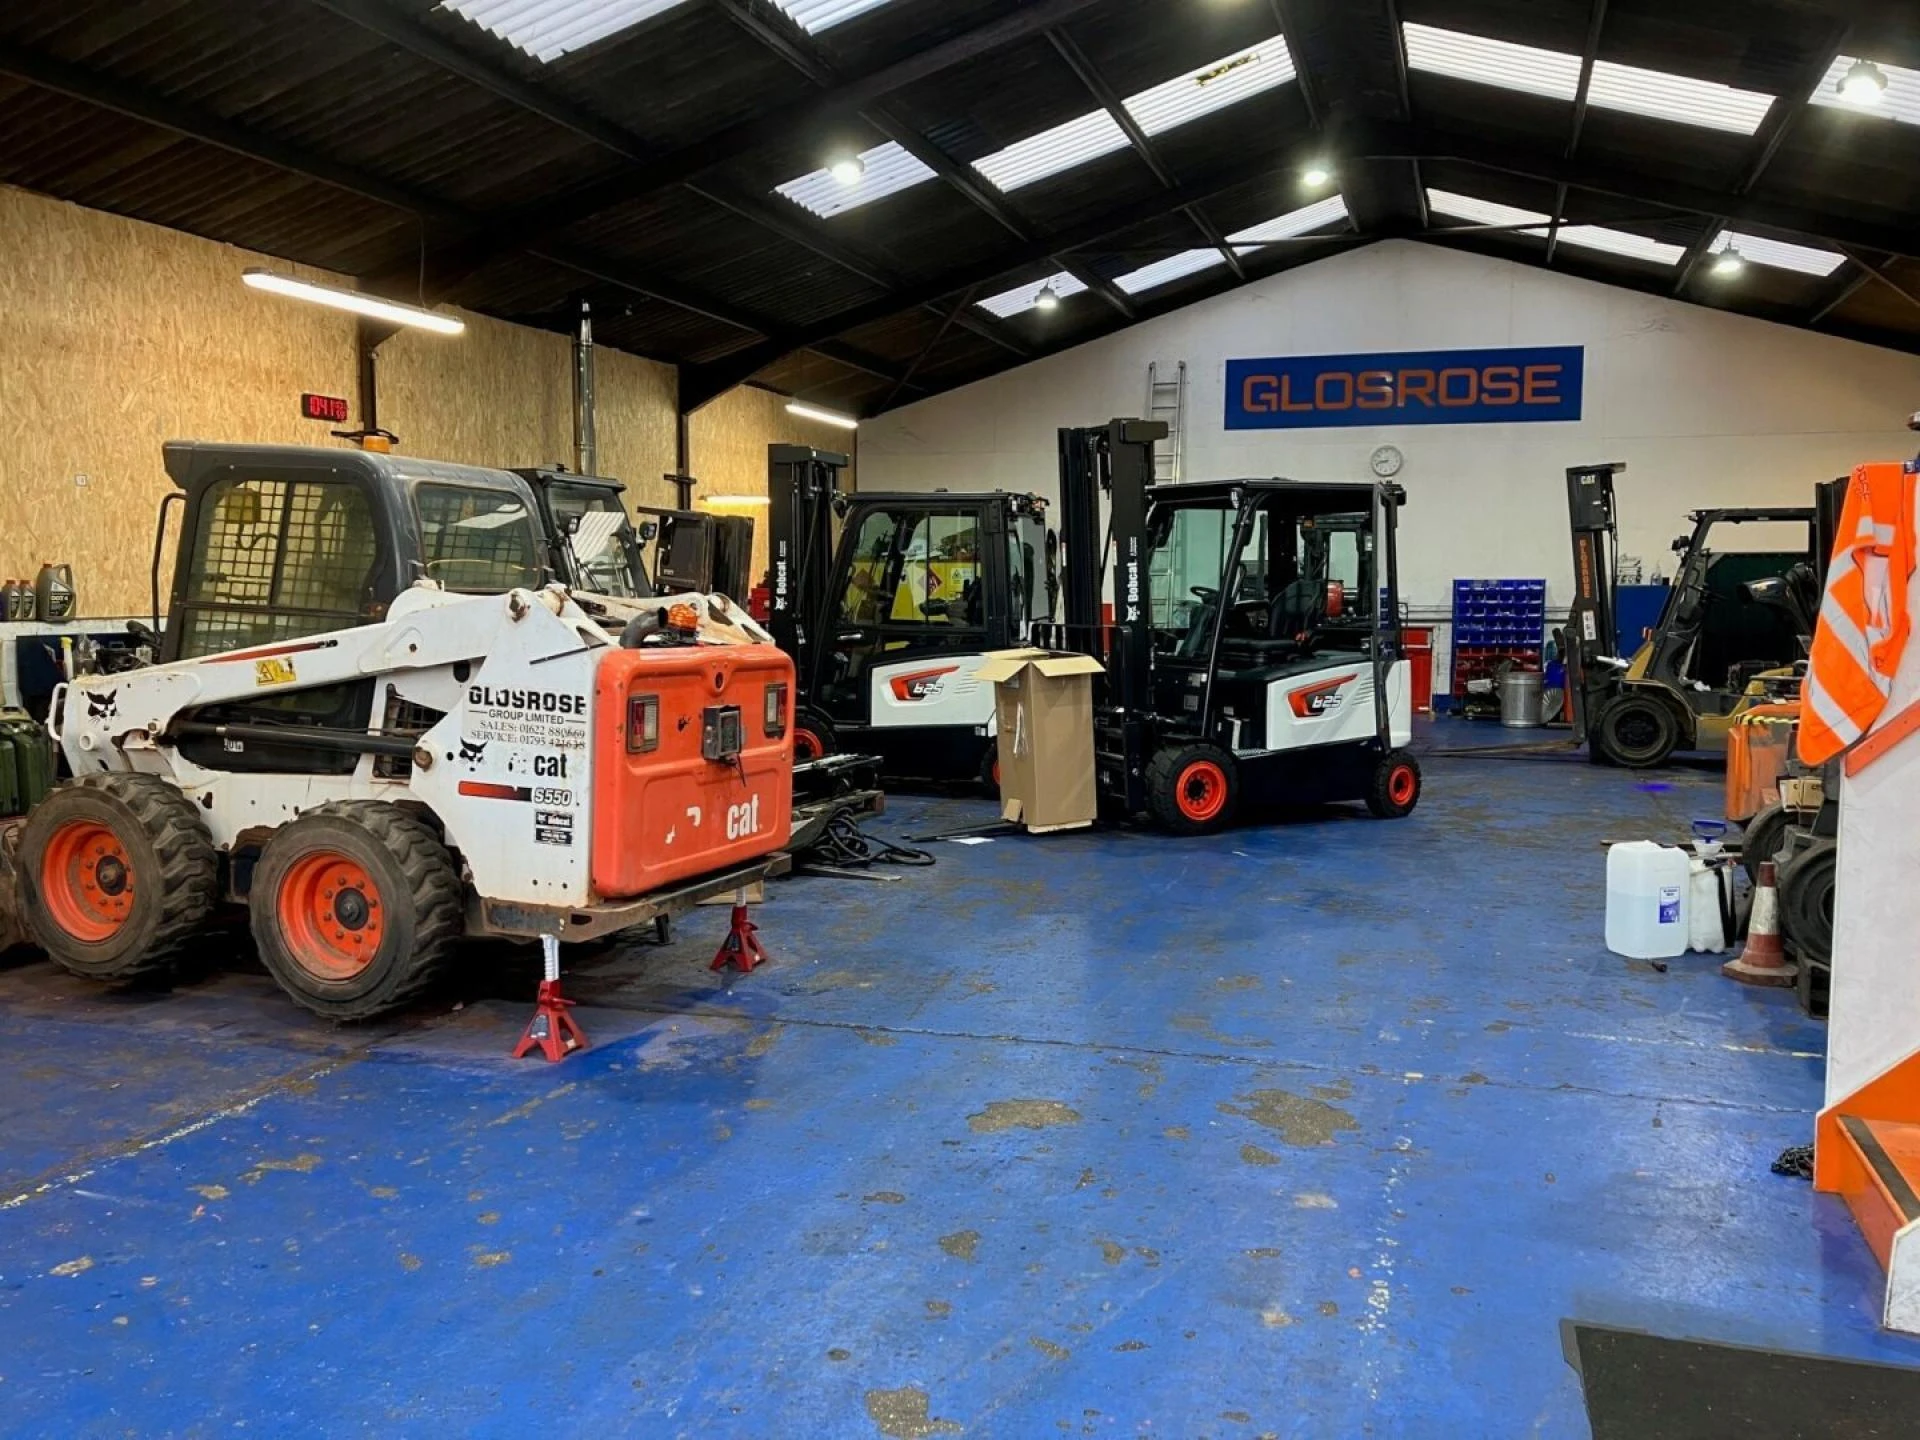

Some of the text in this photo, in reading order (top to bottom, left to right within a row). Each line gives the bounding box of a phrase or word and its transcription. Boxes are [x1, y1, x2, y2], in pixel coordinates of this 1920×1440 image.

[1243, 364, 1562, 412] GLOSROSE
[776, 561, 787, 594] Bobcat
[1126, 561, 1139, 602] Bobcat
[469, 685, 586, 715] GLOSROSE
[480, 720, 517, 731] SALES:
[488, 708, 564, 725] GROUP LIMITED
[534, 788, 572, 807] S550
